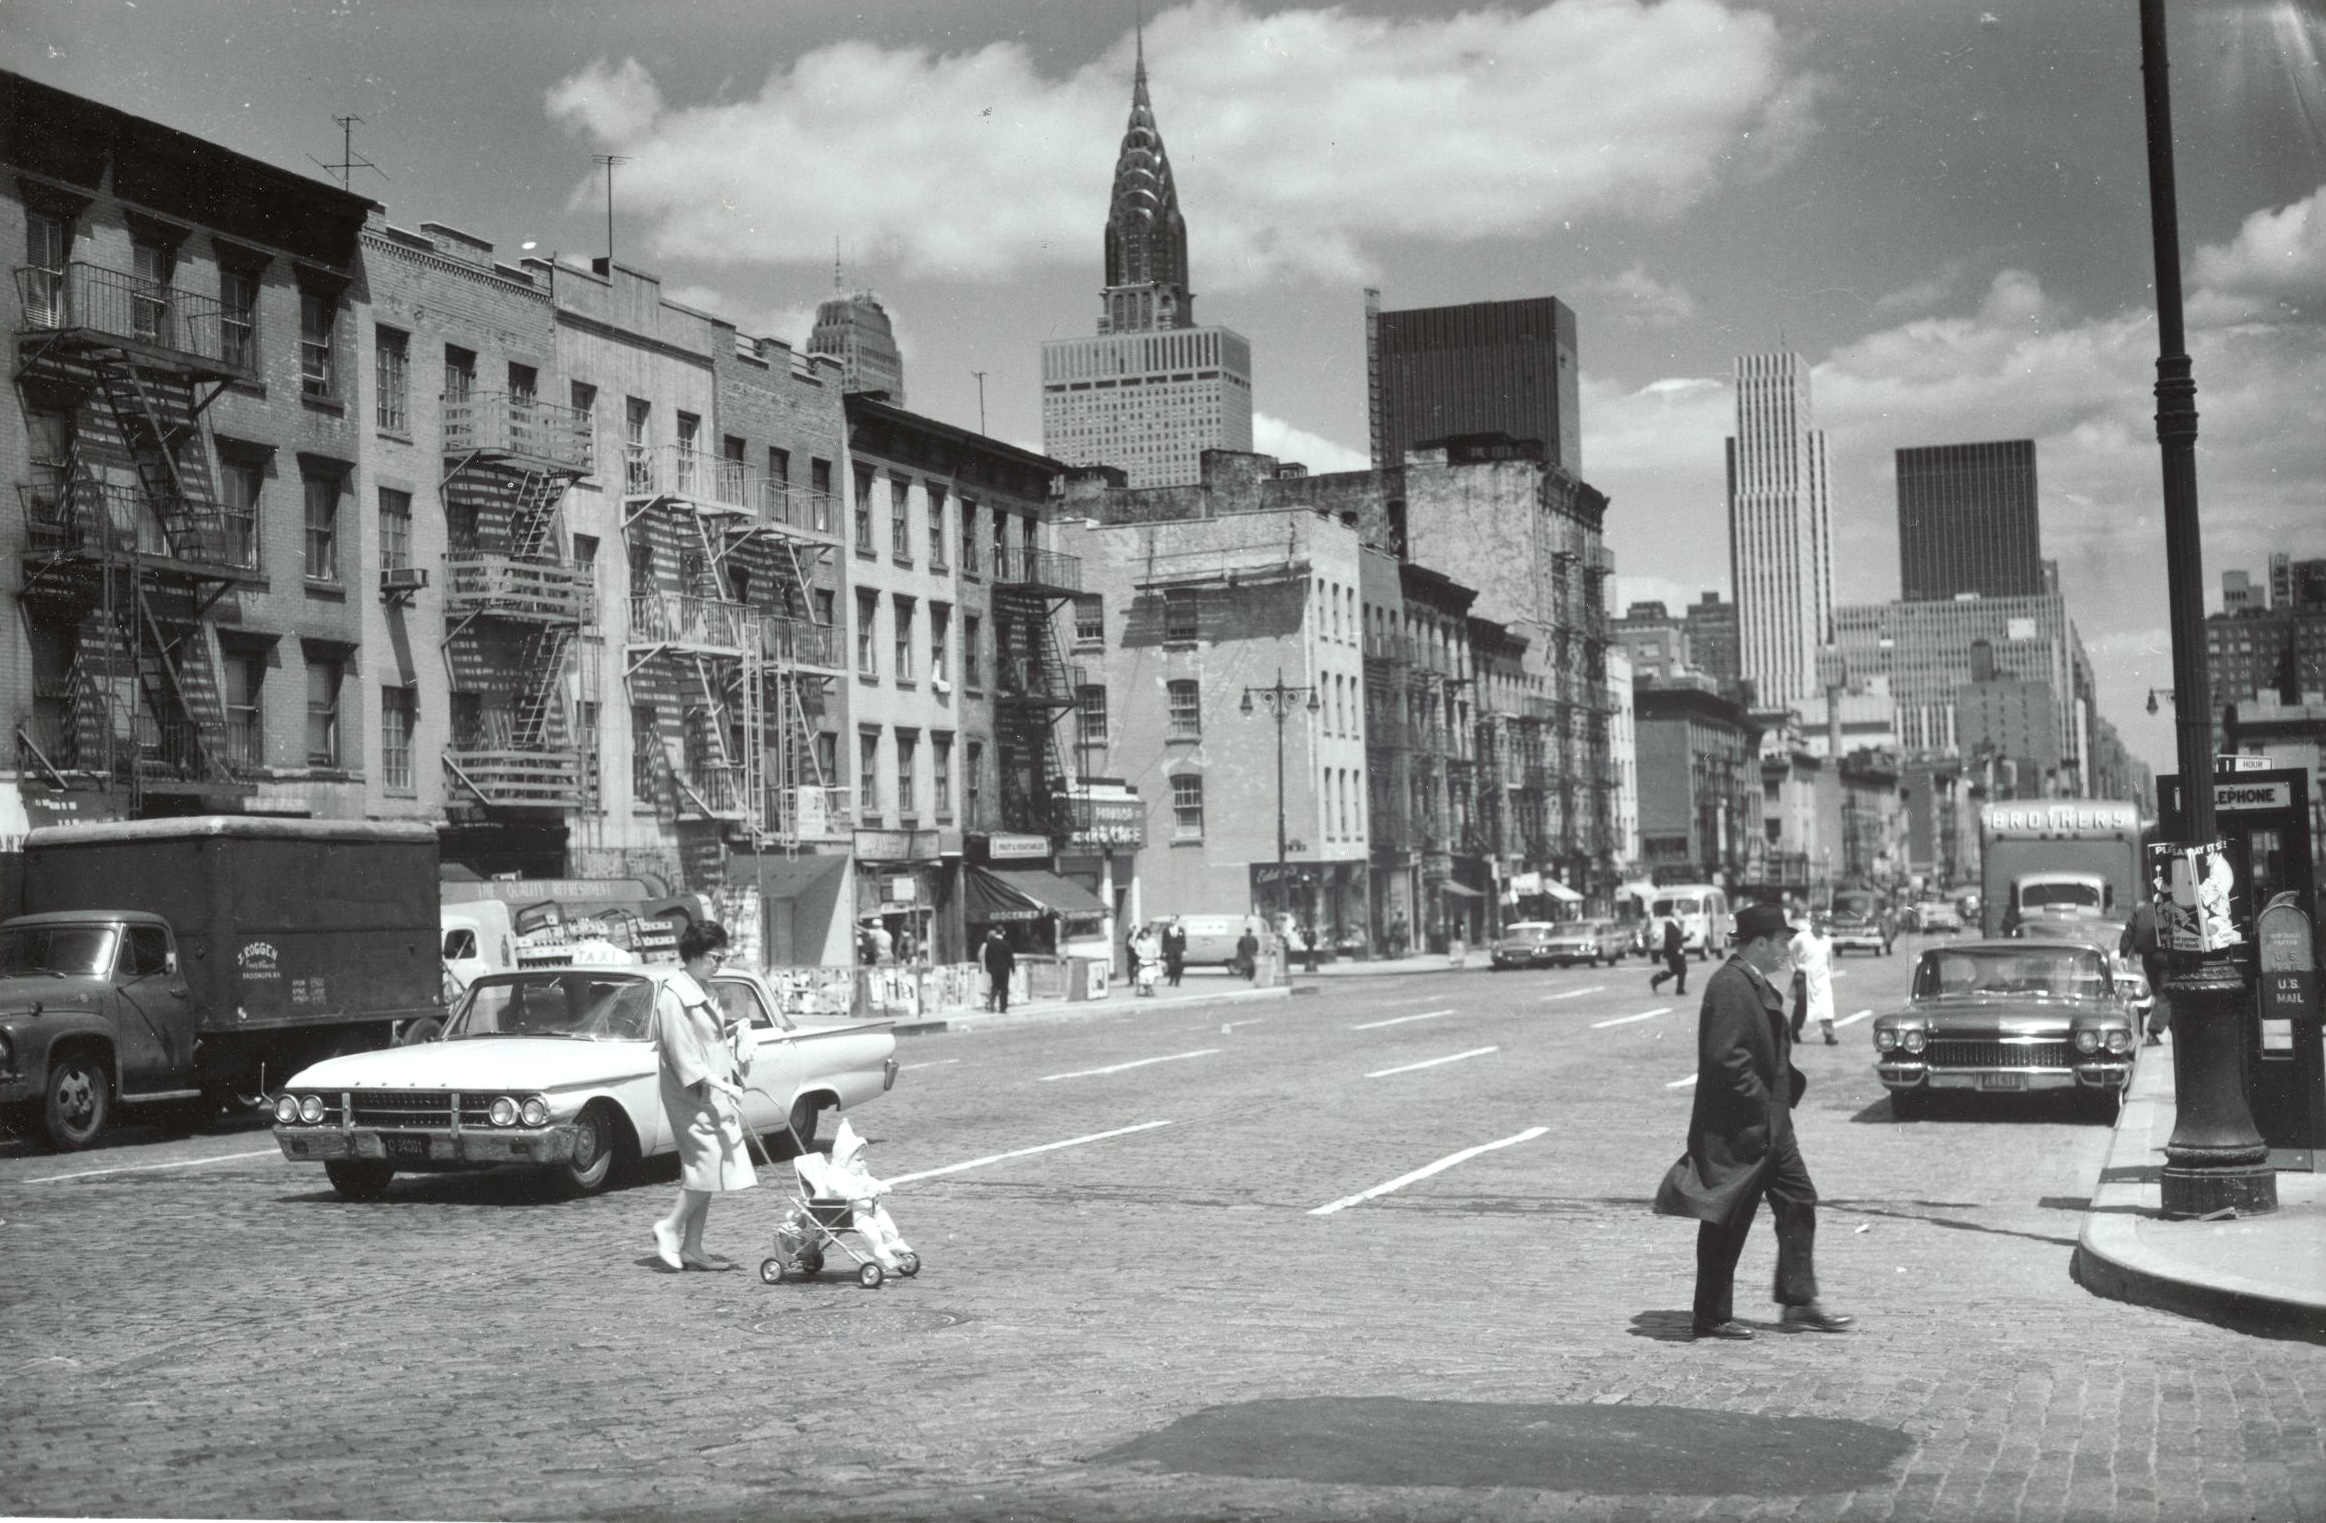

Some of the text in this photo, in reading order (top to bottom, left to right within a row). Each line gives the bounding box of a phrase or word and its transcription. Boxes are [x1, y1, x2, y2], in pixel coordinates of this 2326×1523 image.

[2243, 760, 2263, 769] HOUR
[2215, 788, 2275, 804] EPHONE
[1991, 810, 2125, 830] BROTHERS
[1110, 826, 1141, 843] CAFE
[506, 882, 545, 898] QUALITY
[552, 881, 611, 897] REFRESHMENT
[244, 941, 279, 961] ROGGEN
[577, 950, 616, 964] TAXI
[2277, 978, 2301, 990] U.S.
[2276, 992, 2305, 1004] MAIL
